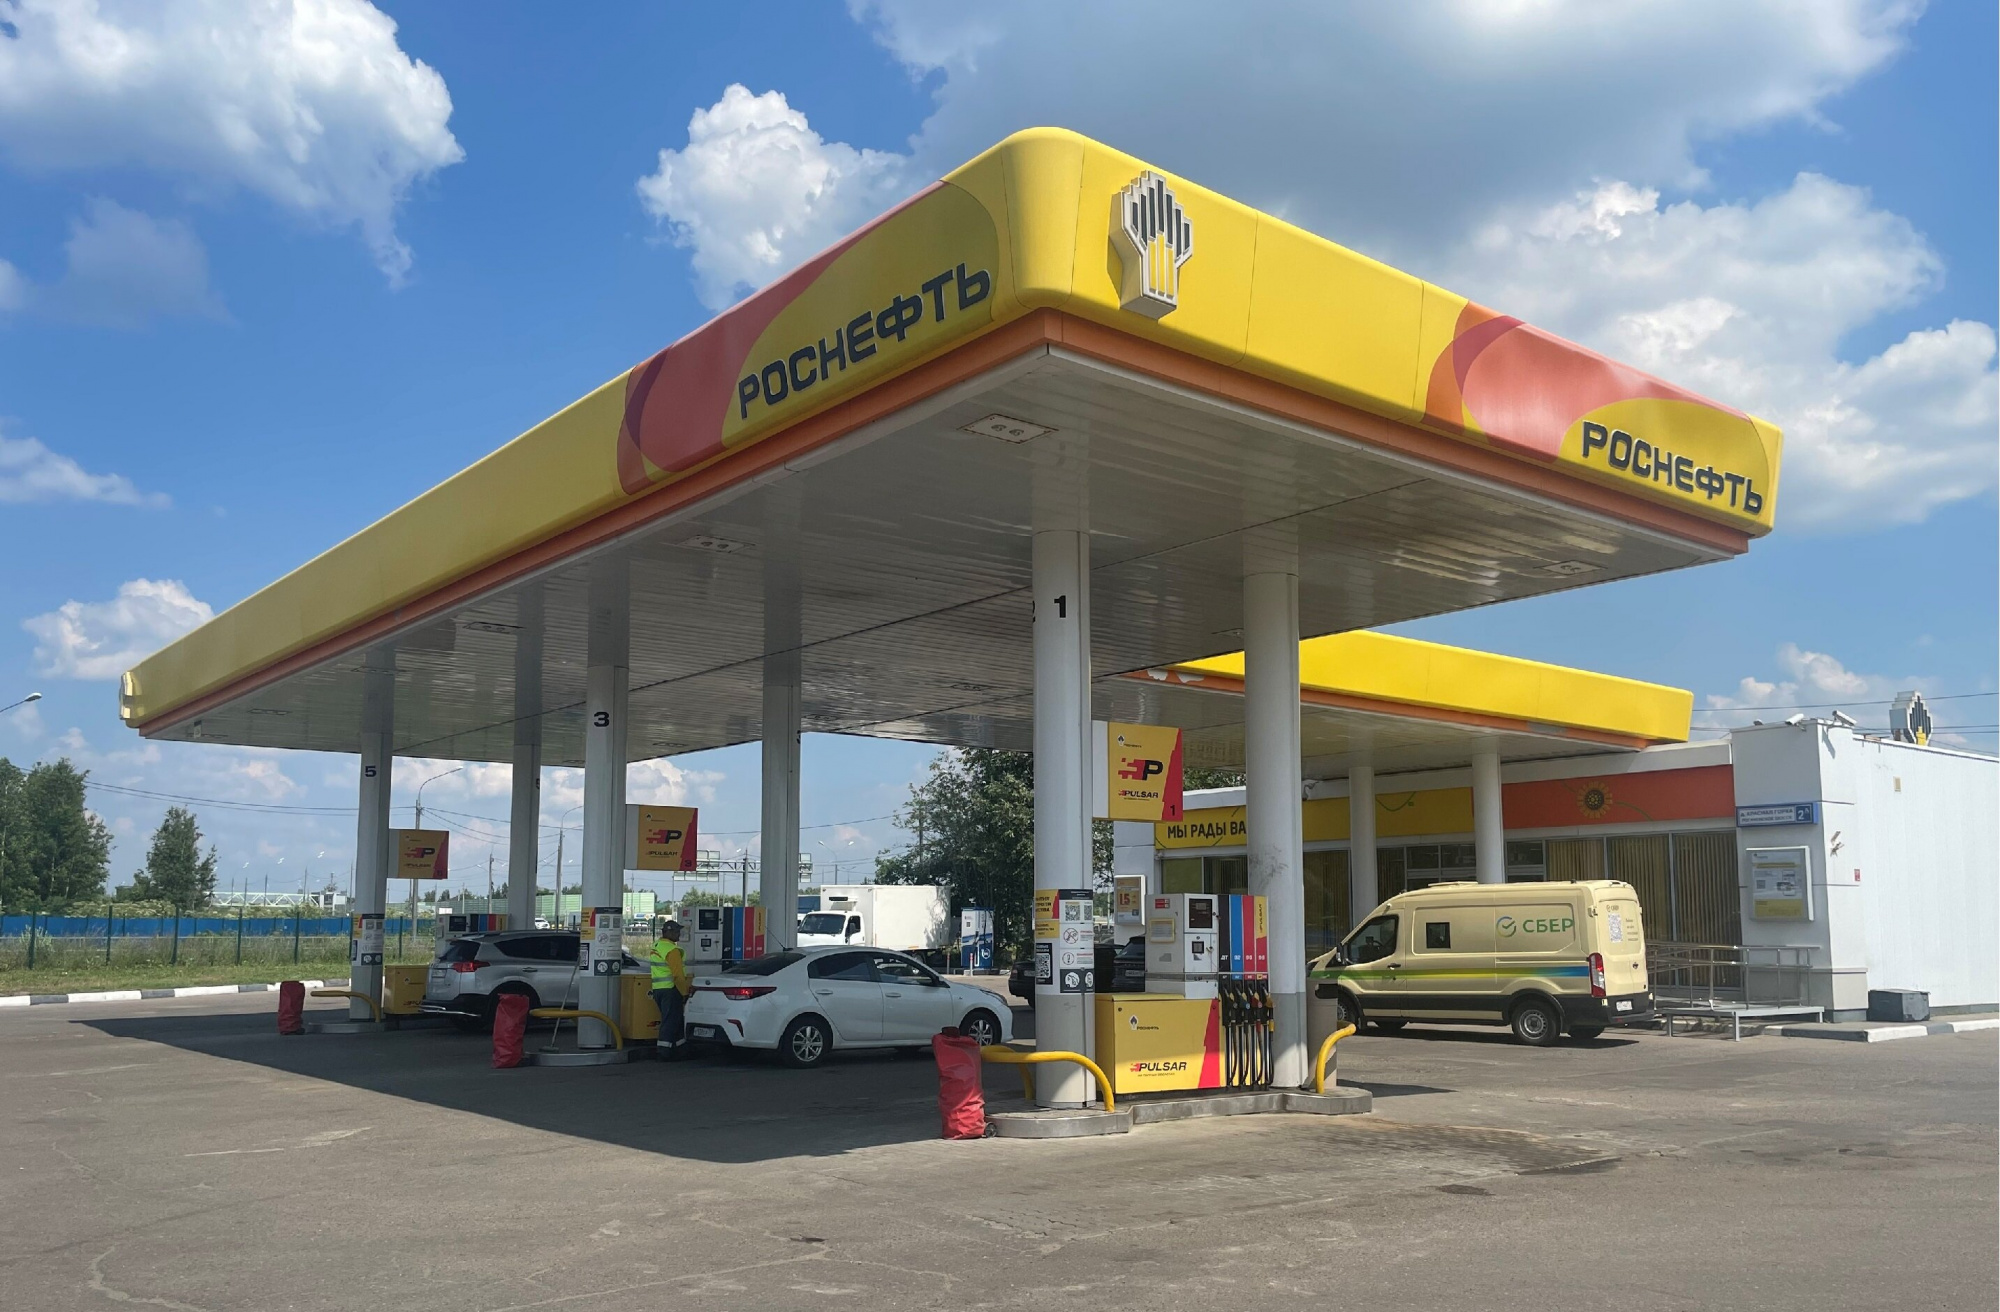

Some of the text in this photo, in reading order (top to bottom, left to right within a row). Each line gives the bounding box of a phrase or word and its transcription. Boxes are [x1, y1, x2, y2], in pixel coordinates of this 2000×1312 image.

[738, 262, 991, 419] РОСНЕФТЬ
[1582, 420, 1764, 514] РОСНЕФТЬ
[1054, 594, 1067, 618] 1
[594, 711, 610, 727] 3
[364, 765, 377, 777] 5
[1142, 760, 1163, 780] P
[1124, 789, 1159, 799] PULSAR
[1169, 804, 1176, 816] 1
[1167, 823, 1188, 840] МЫ
[1190, 821, 1227, 840] РАДЫ
[1523, 917, 1574, 933] СБЕР
[1139, 1061, 1187, 1072] PULSAR
